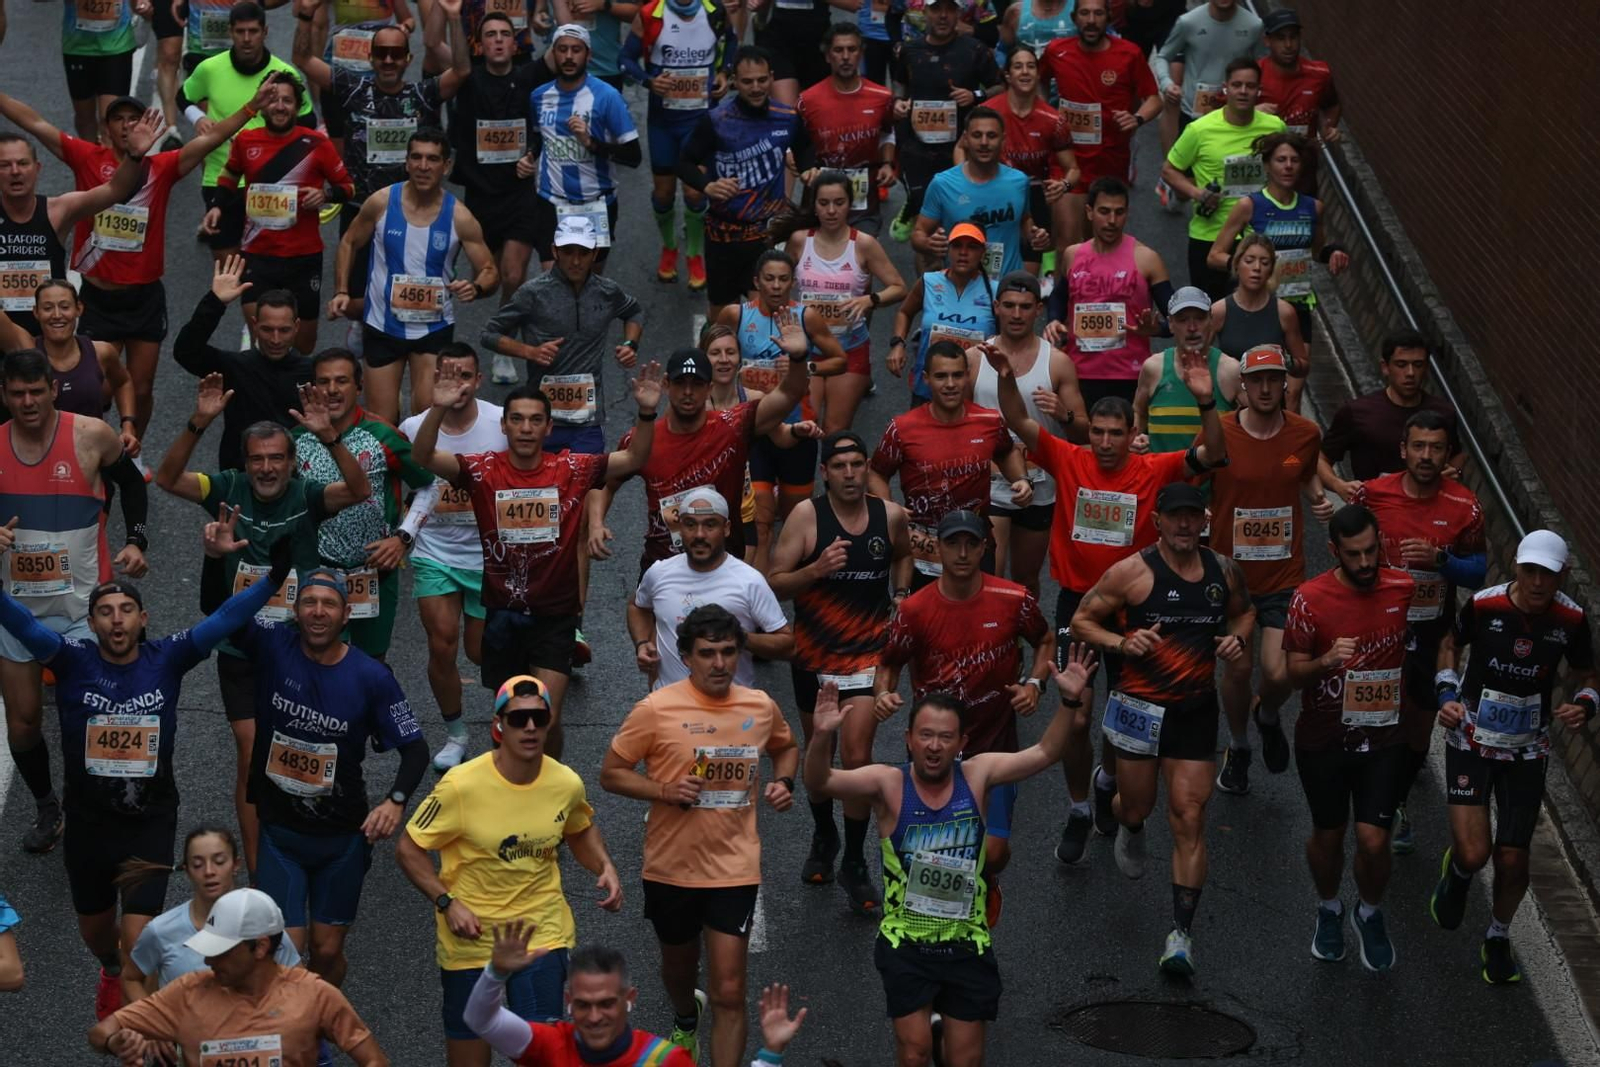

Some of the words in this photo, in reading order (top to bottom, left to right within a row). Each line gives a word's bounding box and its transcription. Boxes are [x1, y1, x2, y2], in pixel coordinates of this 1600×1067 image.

[917, 112, 944, 124] 5744
[375, 131, 407, 143] 8222
[484, 131, 515, 144] 4522
[1231, 165, 1262, 178] 8123
[250, 195, 288, 211] 13714
[97, 213, 138, 233] 11399
[2, 275, 38, 289] 5566
[399, 287, 433, 302] 4561
[1081, 315, 1113, 330] 5598
[548, 387, 582, 402] 3684
[442, 488, 469, 504] 436
[506, 502, 544, 519] 4170
[1084, 503, 1122, 522] 9318
[1243, 521, 1280, 537] 6245
[910, 535, 935, 554] 545
[17, 556, 55, 573] 5350
[1355, 684, 1391, 702] 5343
[272, 692, 349, 733] ESTUTIENDA
[1115, 706, 1147, 732] 1623
[97, 731, 143, 749] 4824
[279, 750, 320, 775] 4839
[706, 762, 745, 780] 6186
[919, 867, 963, 891] 6936
